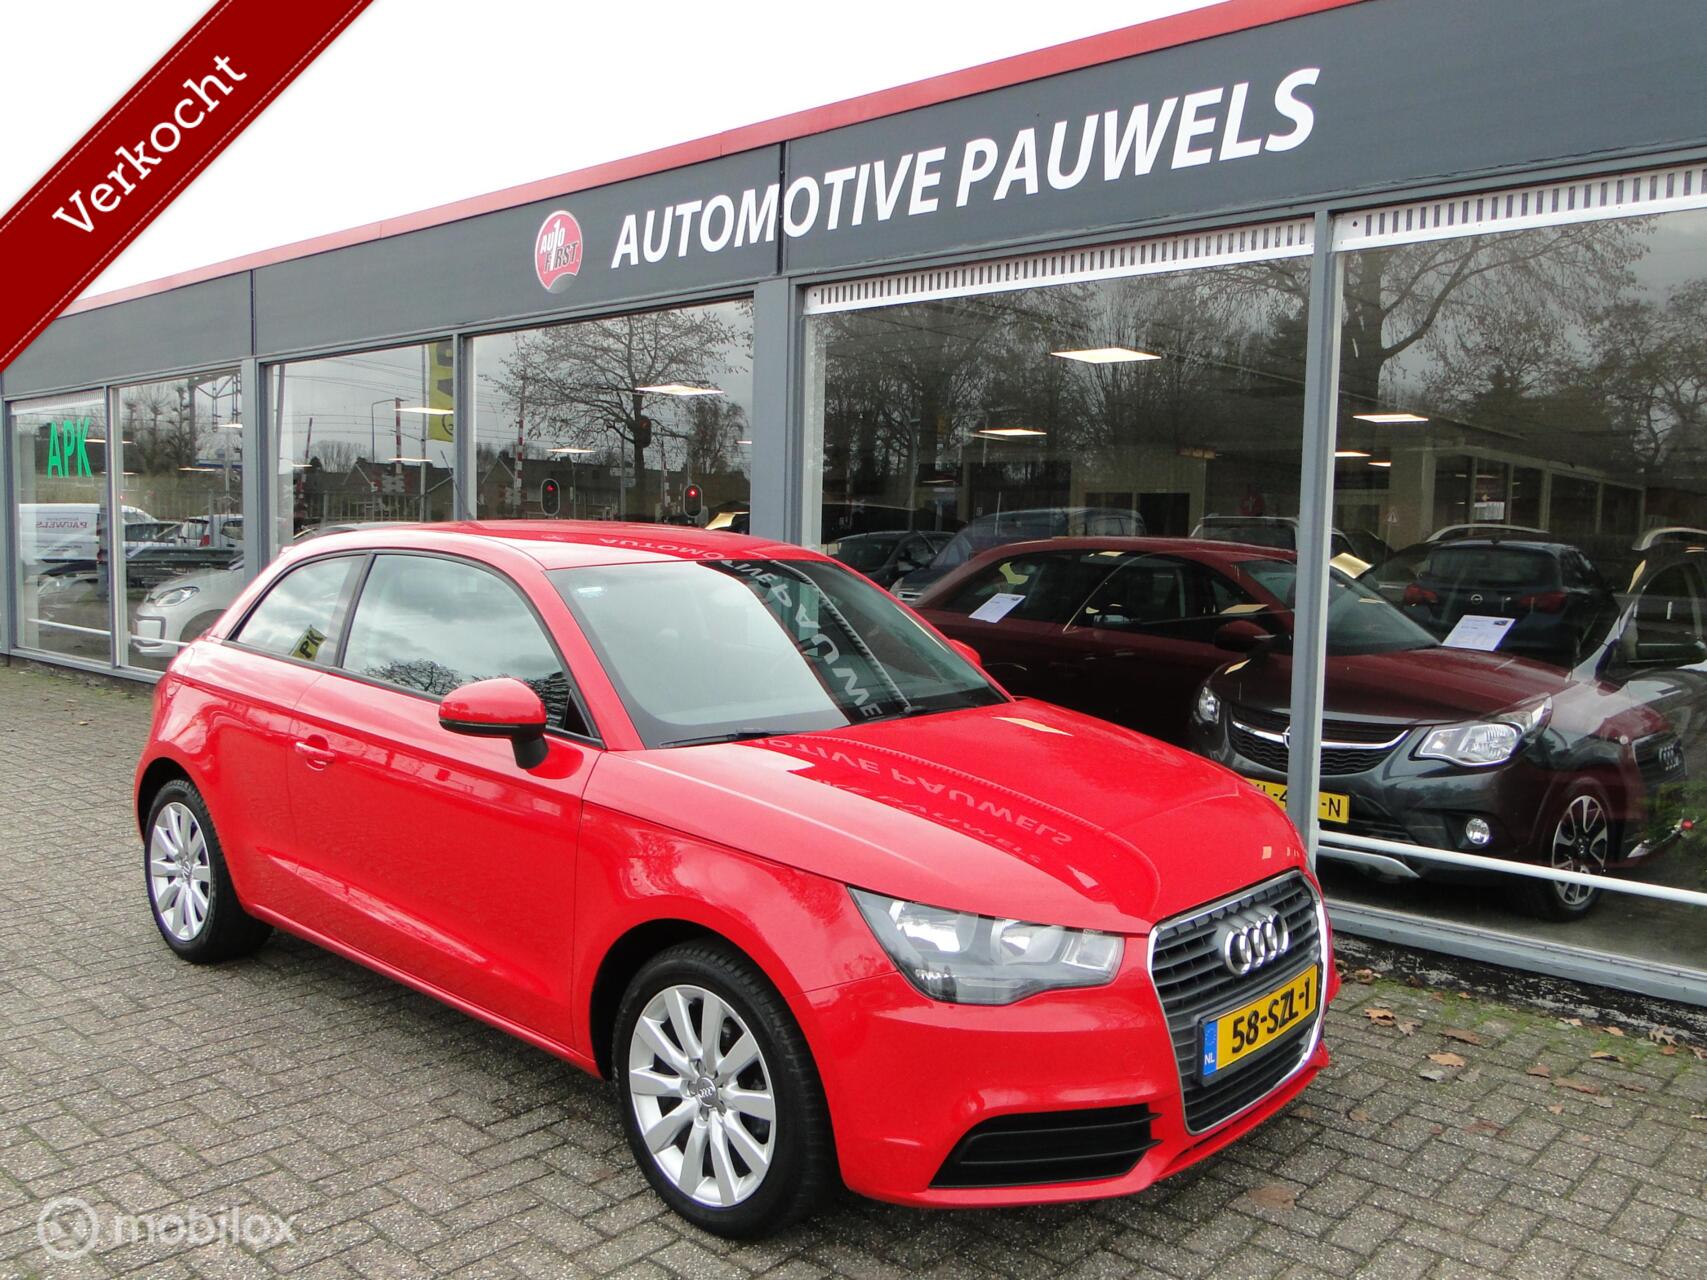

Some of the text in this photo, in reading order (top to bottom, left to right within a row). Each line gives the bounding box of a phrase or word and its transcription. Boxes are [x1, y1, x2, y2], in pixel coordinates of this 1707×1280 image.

[611, 67, 1321, 269] AUTOMOTIVE PAUWELS
[47, 417, 92, 478] APK
[1231, 976, 1311, 1054] 58-SZL-1
[1204, 1053, 1215, 1064] NL
